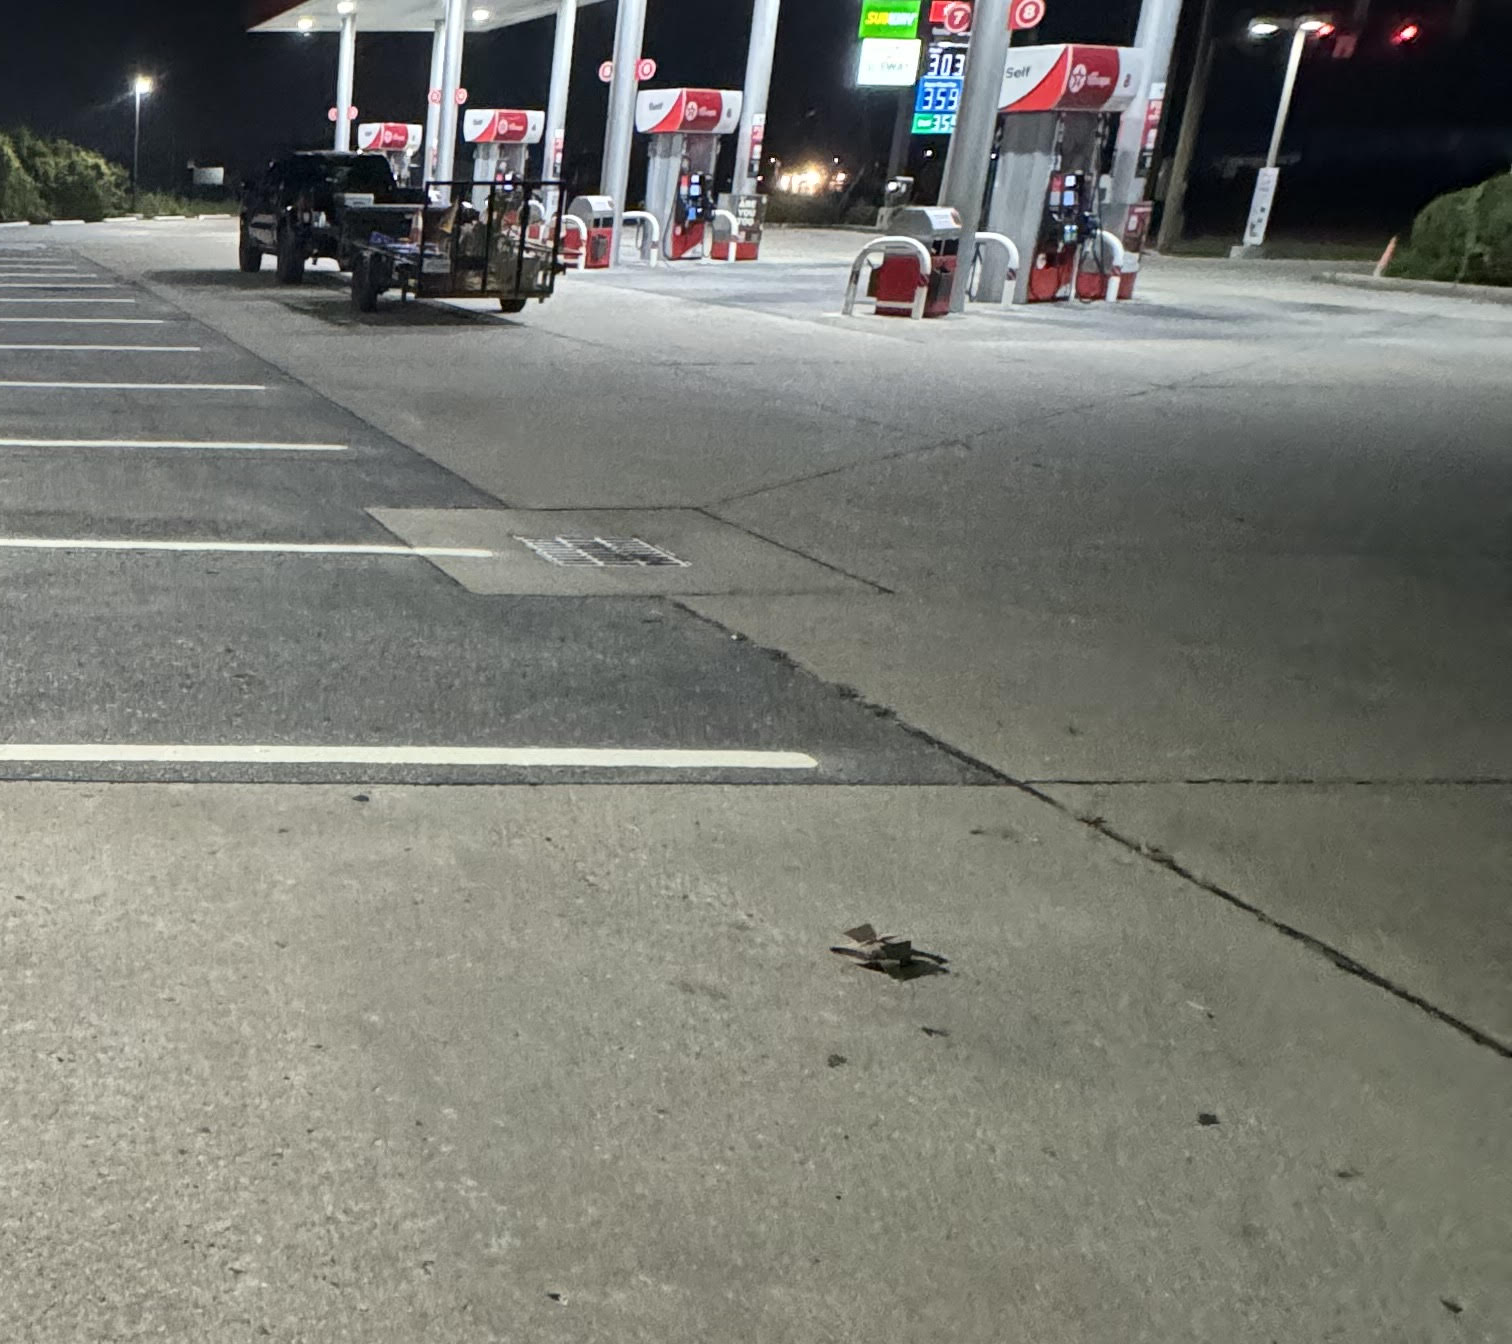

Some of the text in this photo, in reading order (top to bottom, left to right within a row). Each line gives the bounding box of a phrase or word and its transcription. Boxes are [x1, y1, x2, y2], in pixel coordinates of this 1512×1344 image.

[953, 10, 965, 25] 7
[1023, 4, 1036, 20] 8
[927, 54, 965, 76] 303
[1005, 66, 1031, 79] Self
[922, 88, 960, 110] 359
